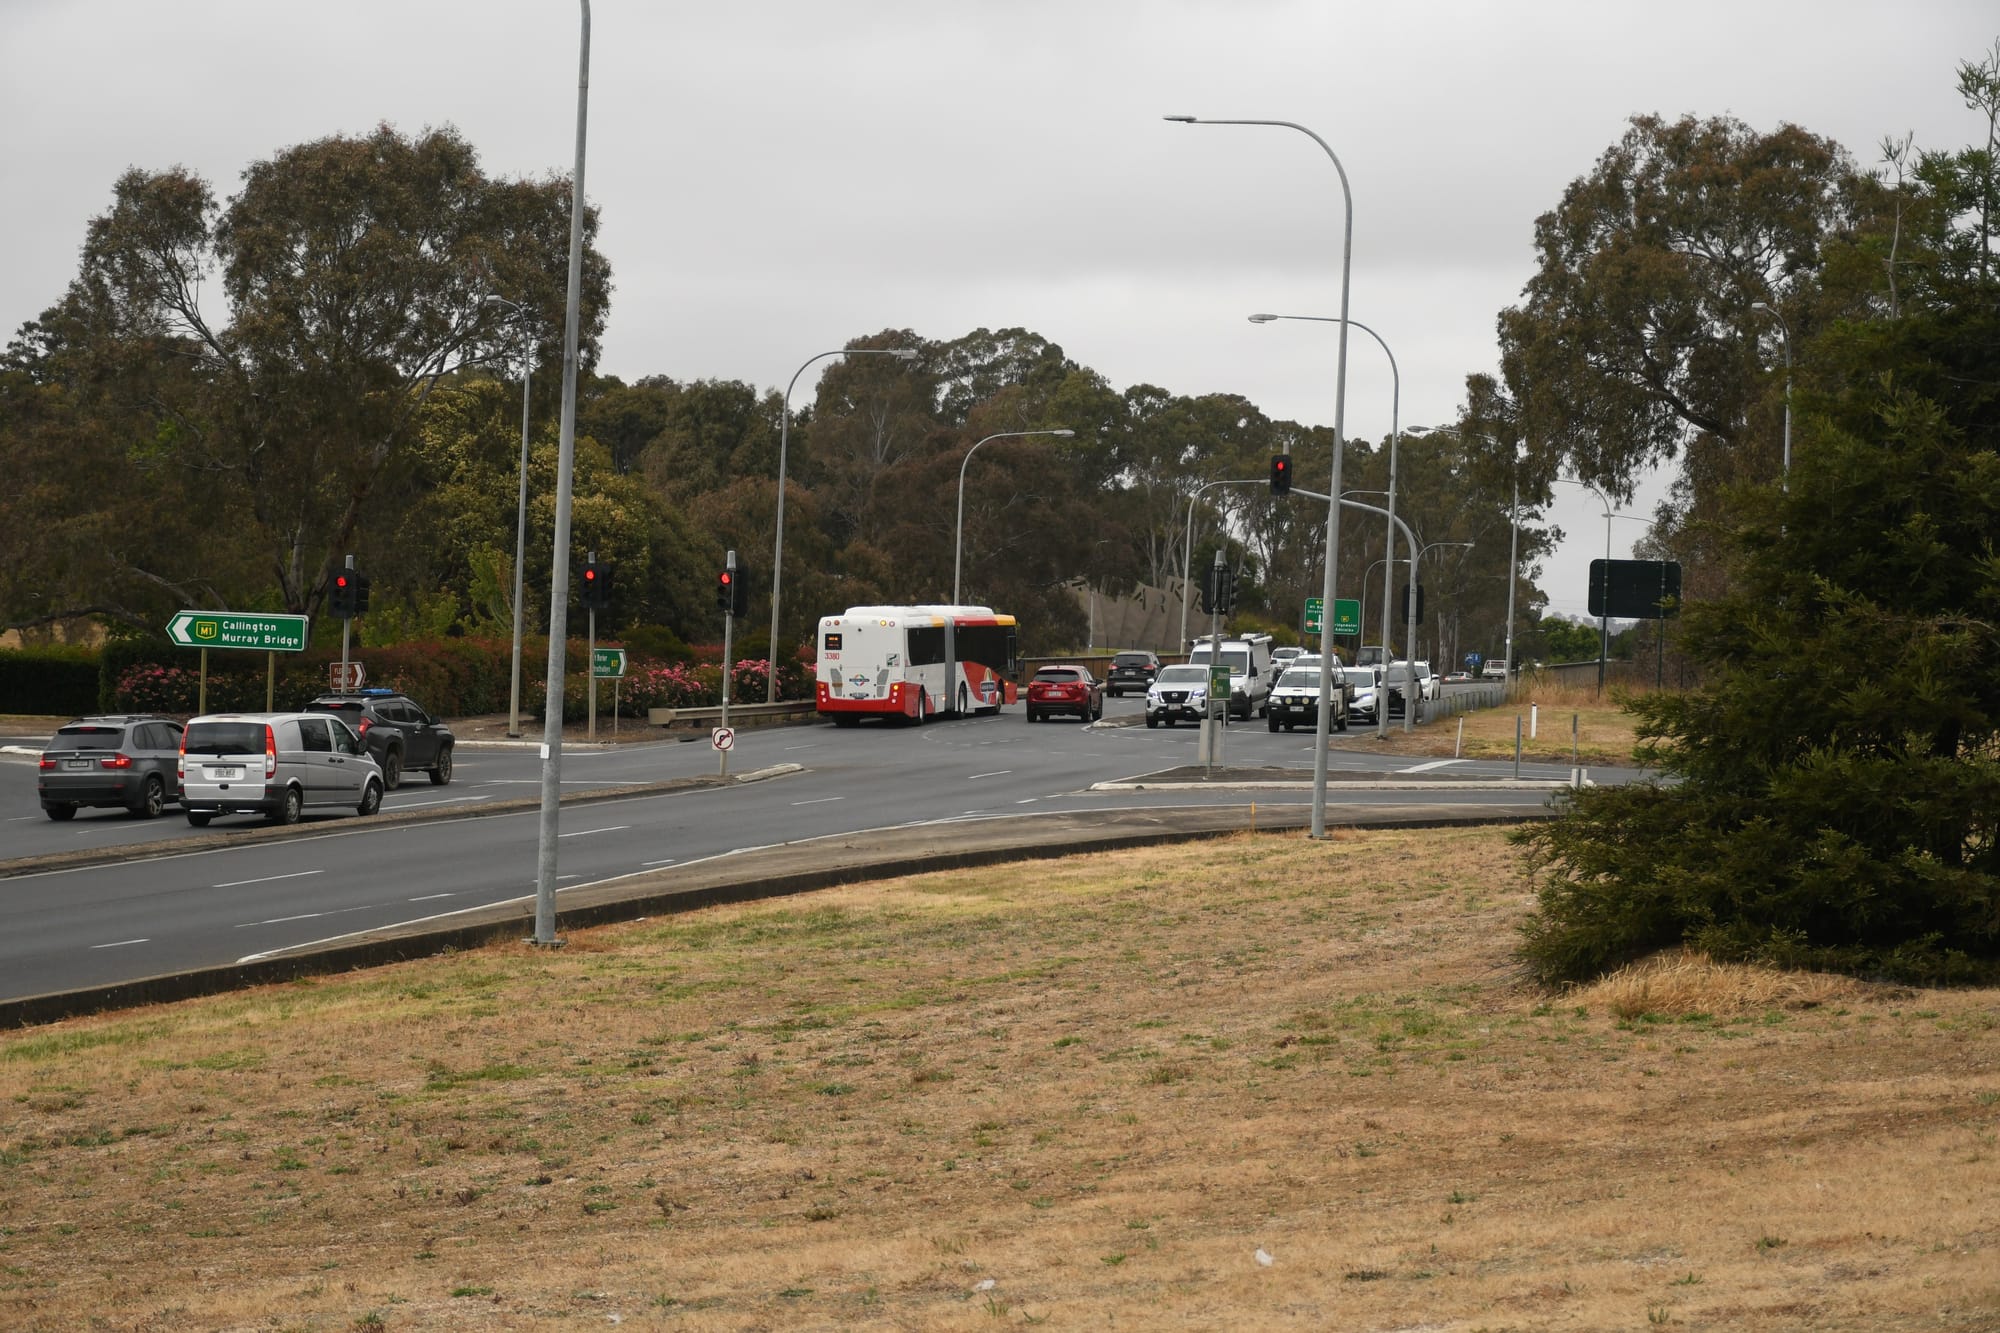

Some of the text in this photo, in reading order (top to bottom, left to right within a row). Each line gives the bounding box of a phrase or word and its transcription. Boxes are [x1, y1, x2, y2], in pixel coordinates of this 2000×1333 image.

[201, 627, 212, 635] M1
[222, 621, 277, 632] Callington
[222, 633, 299, 647] Murray Bridge
